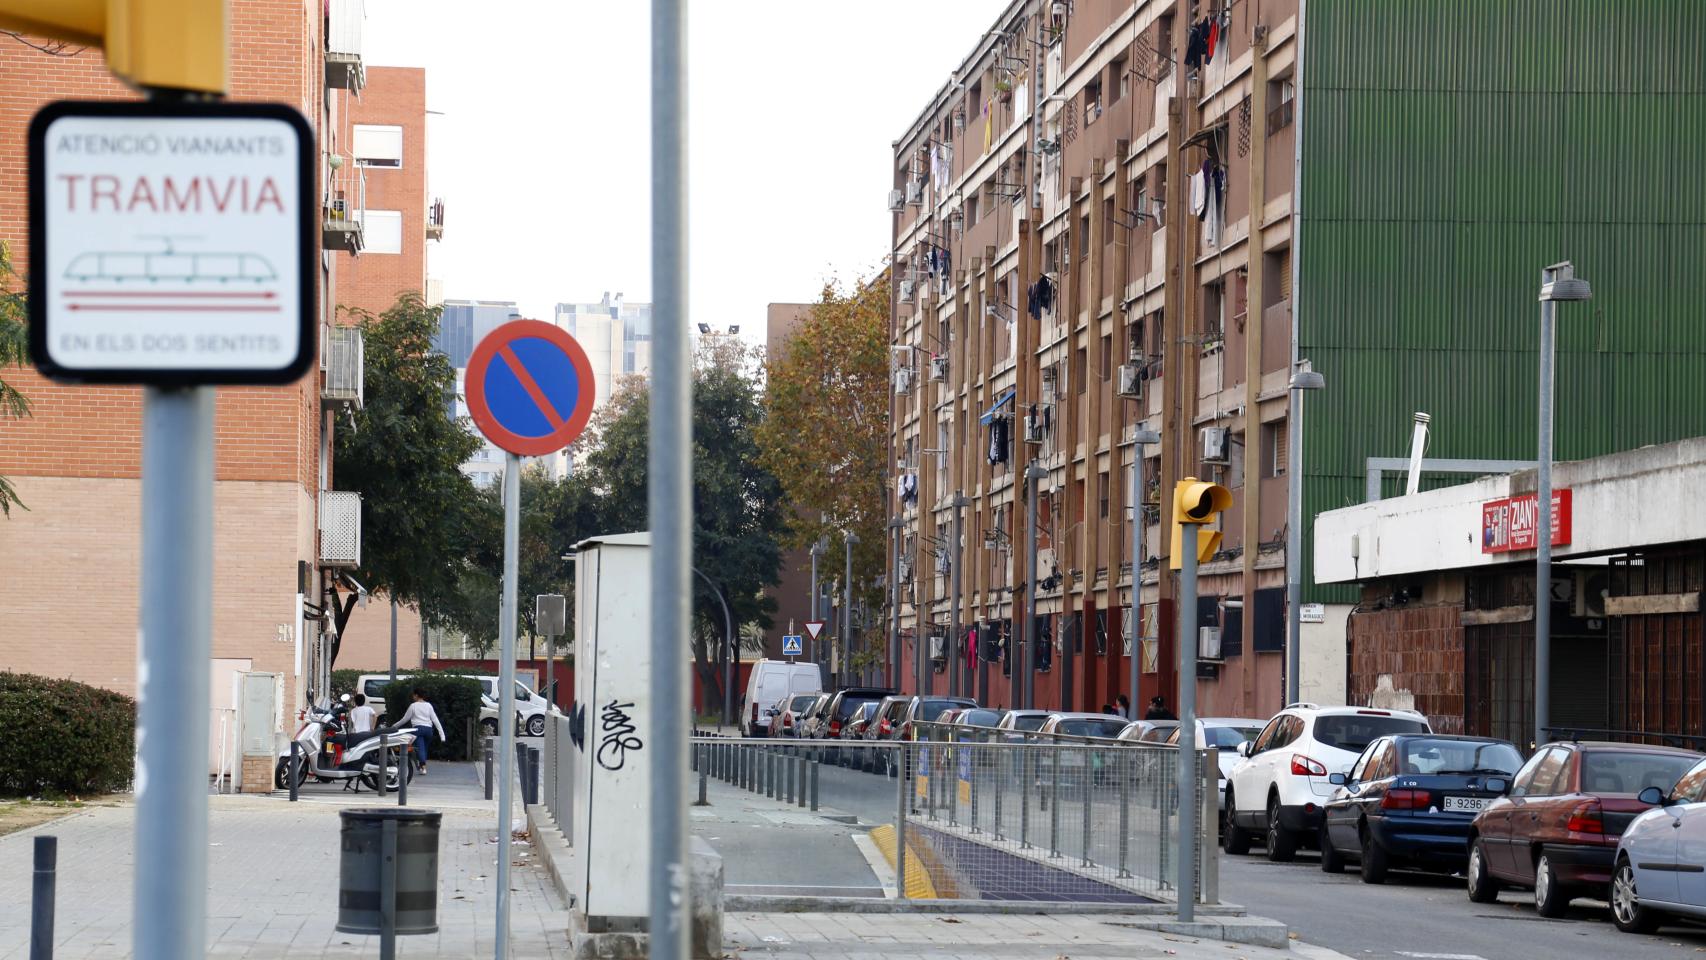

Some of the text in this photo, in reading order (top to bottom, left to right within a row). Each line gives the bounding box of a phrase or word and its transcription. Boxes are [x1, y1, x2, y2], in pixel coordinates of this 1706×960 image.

[166, 135, 285, 157] VIANANTS
[57, 173, 286, 214] TRAMVIA
[60, 334, 281, 353] EN ELS DOS SENTITS
[1511, 500, 1532, 530] ZIAN
